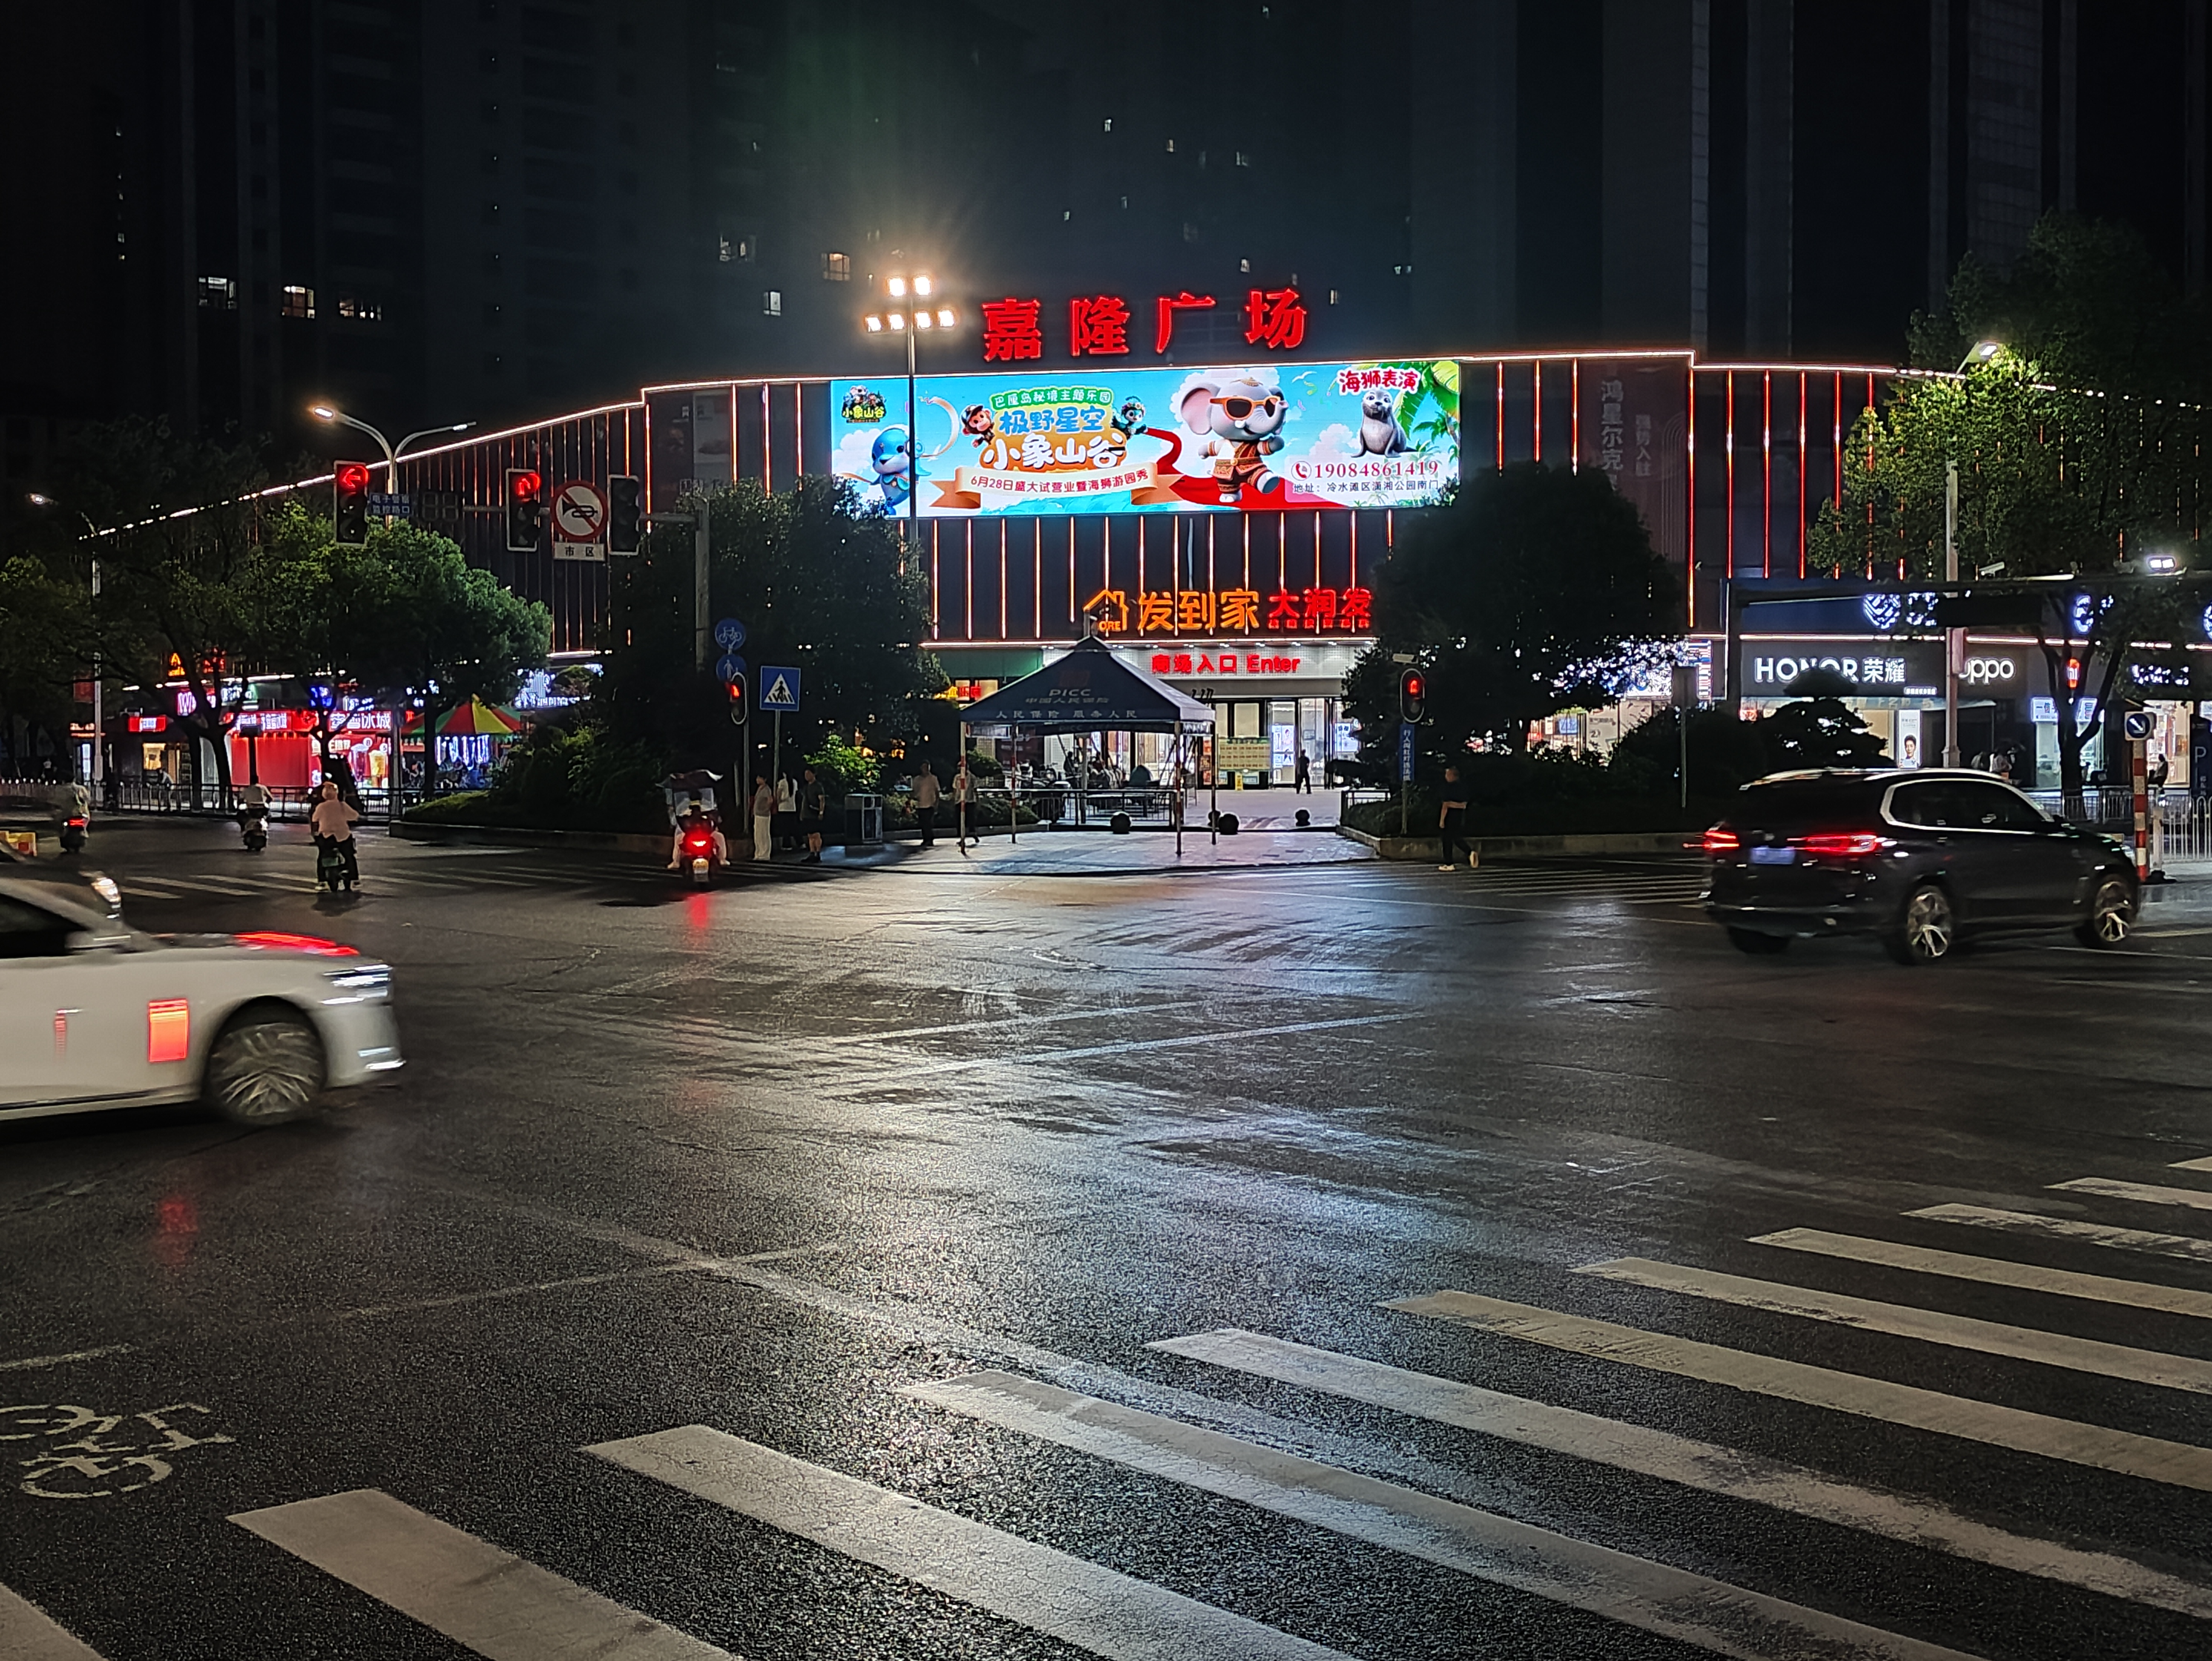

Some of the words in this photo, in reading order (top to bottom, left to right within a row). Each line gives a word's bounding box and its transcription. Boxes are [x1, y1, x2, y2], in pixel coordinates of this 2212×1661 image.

[983, 288, 1307, 362] 嘉隆广场
[1339, 369, 1418, 392] 海狮表演
[994, 389, 1111, 407] 巴厘岛秘境主题乐园
[842, 406, 885, 419] 小象山谷
[999, 406, 1106, 434] 极野星空
[1601, 380, 1624, 491] 鸿星尔克
[983, 433, 1125, 470] 小象山谷
[1315, 461, 1438, 478] 19084861419
[565, 545, 594, 557] 市区
[1139, 589, 1260, 631] 发到家
[1268, 588, 1371, 618] 大润发
[1151, 654, 1237, 674] 商场入口
[1247, 654, 1300, 674] Enter
[1863, 657, 1905, 683] 荣耀
[996, 710, 1060, 719] 人民保险
